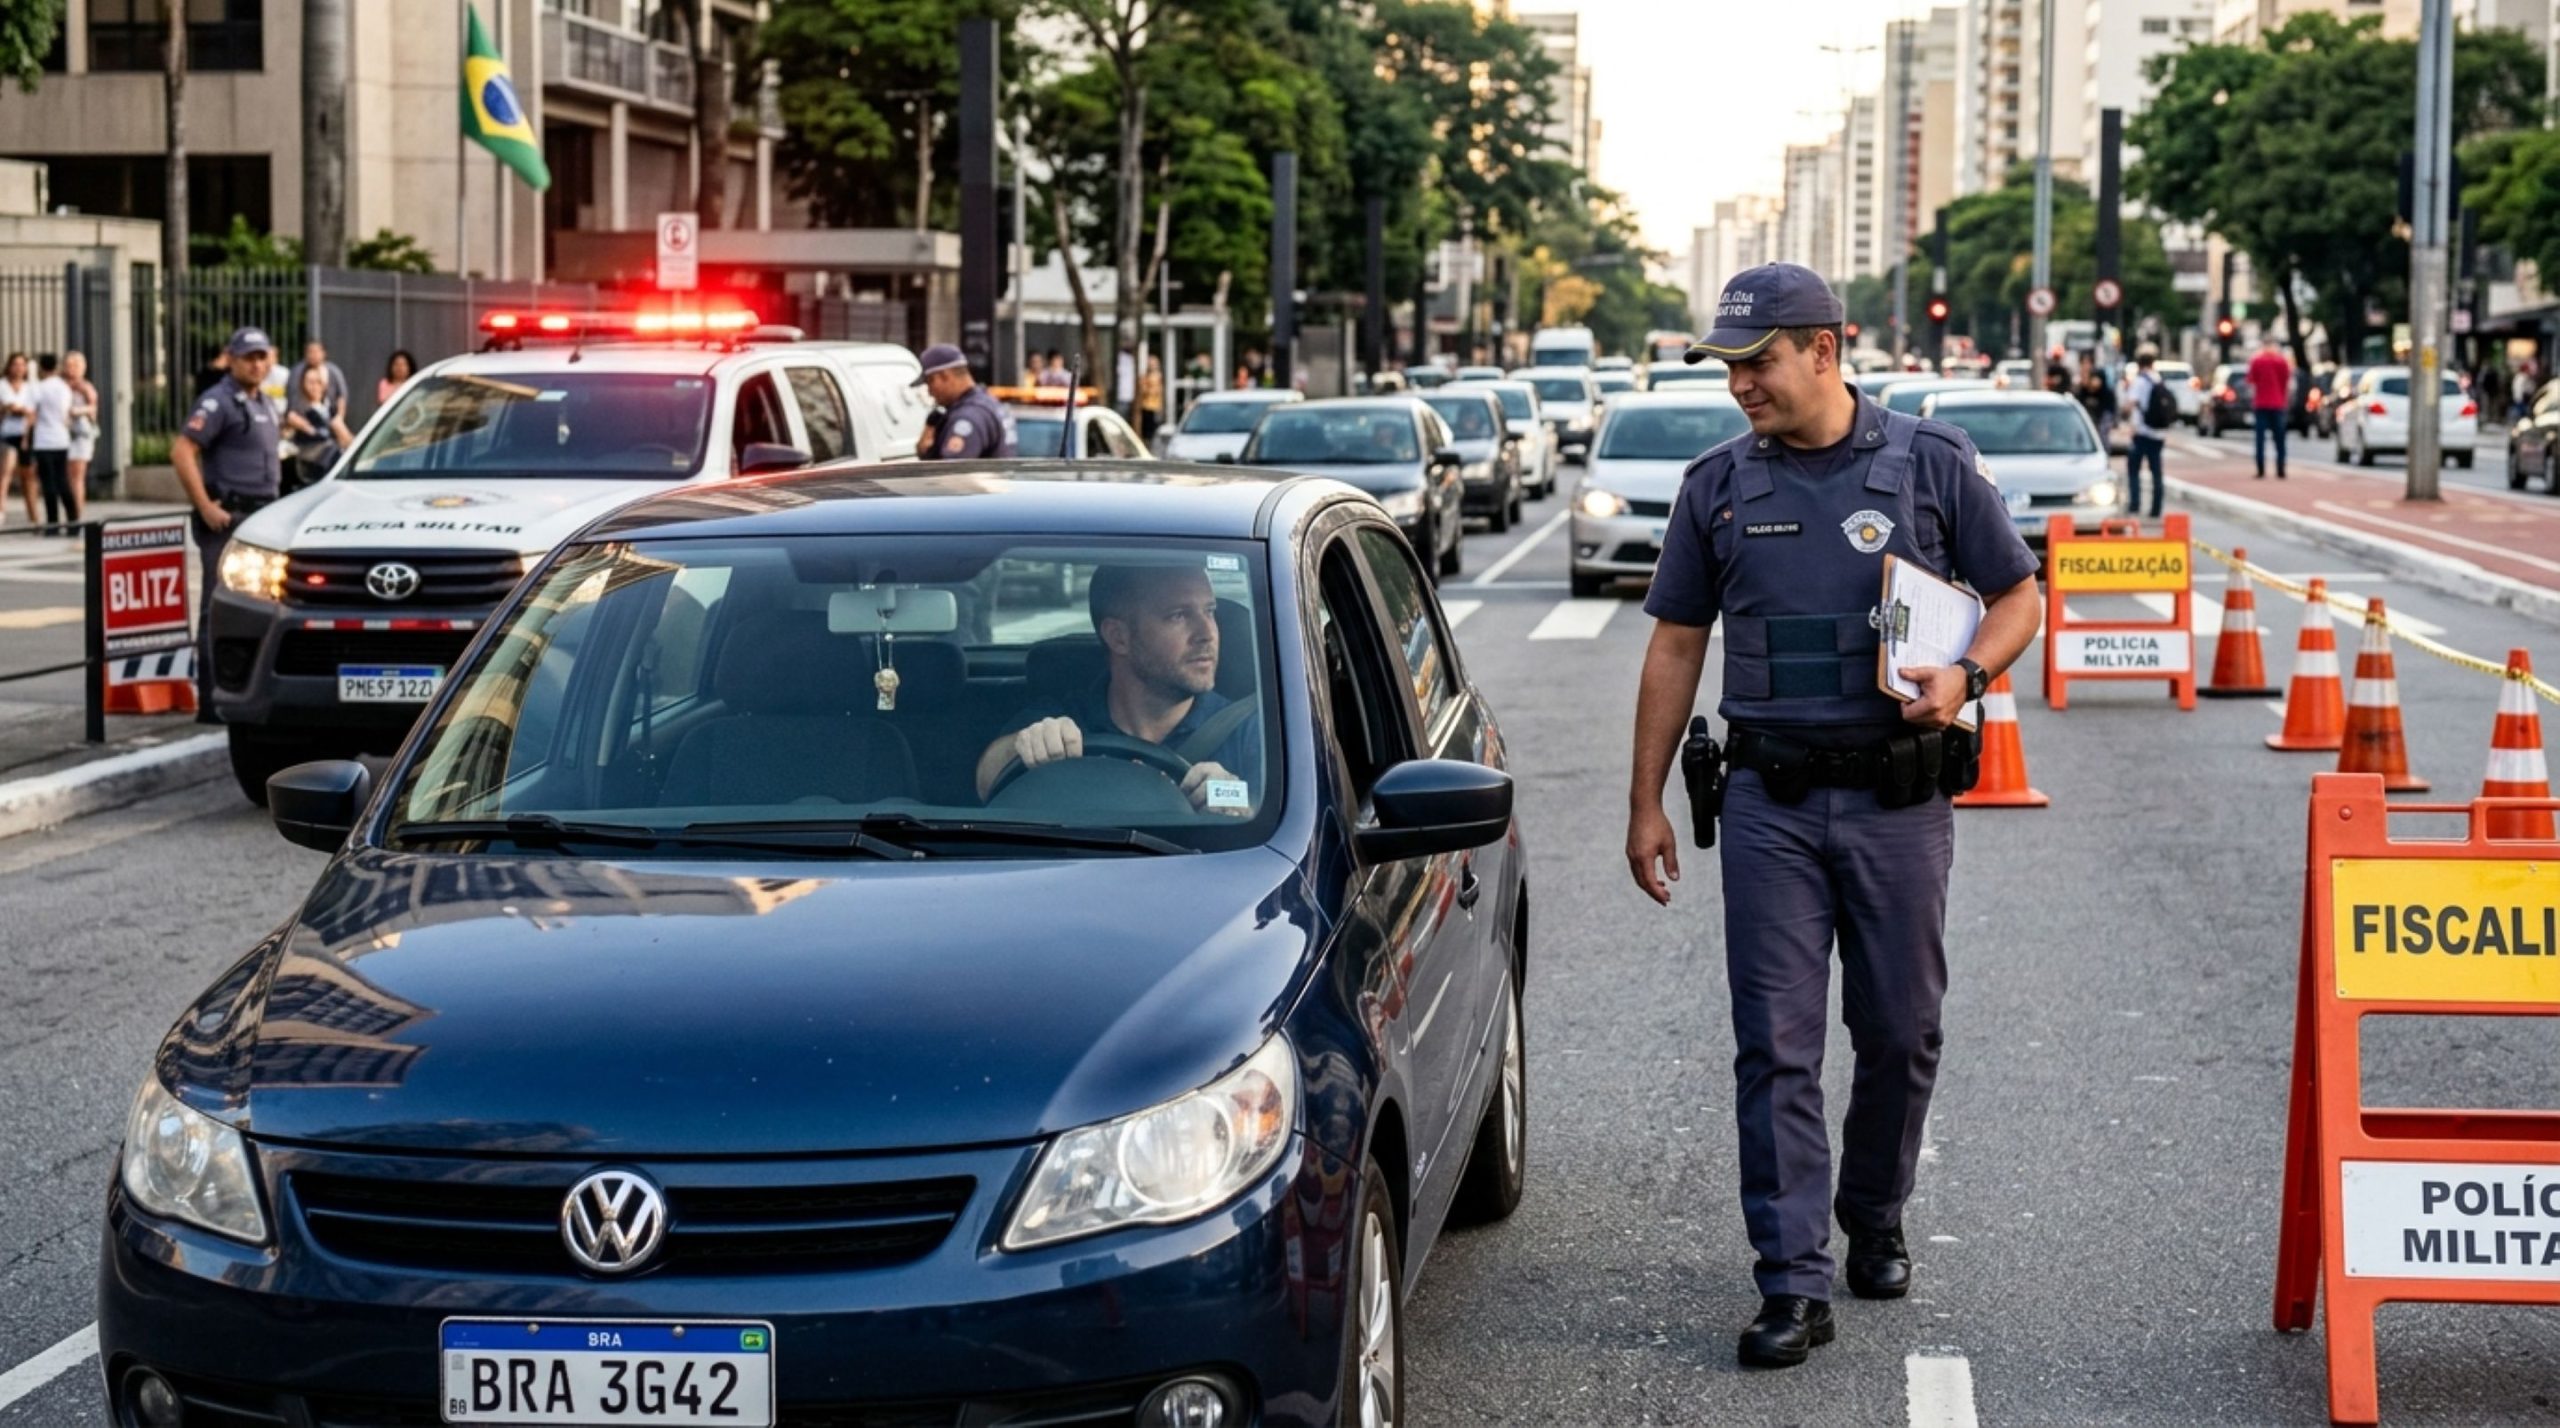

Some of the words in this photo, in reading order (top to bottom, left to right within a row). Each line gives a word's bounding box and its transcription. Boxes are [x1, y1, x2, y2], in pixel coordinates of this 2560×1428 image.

[109, 566, 181, 612] BLITZ
[2353, 904, 2556, 956] FISCALI
[588, 1332, 622, 1347] BRA
[472, 1358, 575, 1413] BRA
[600, 1360, 739, 1416] 3G42
